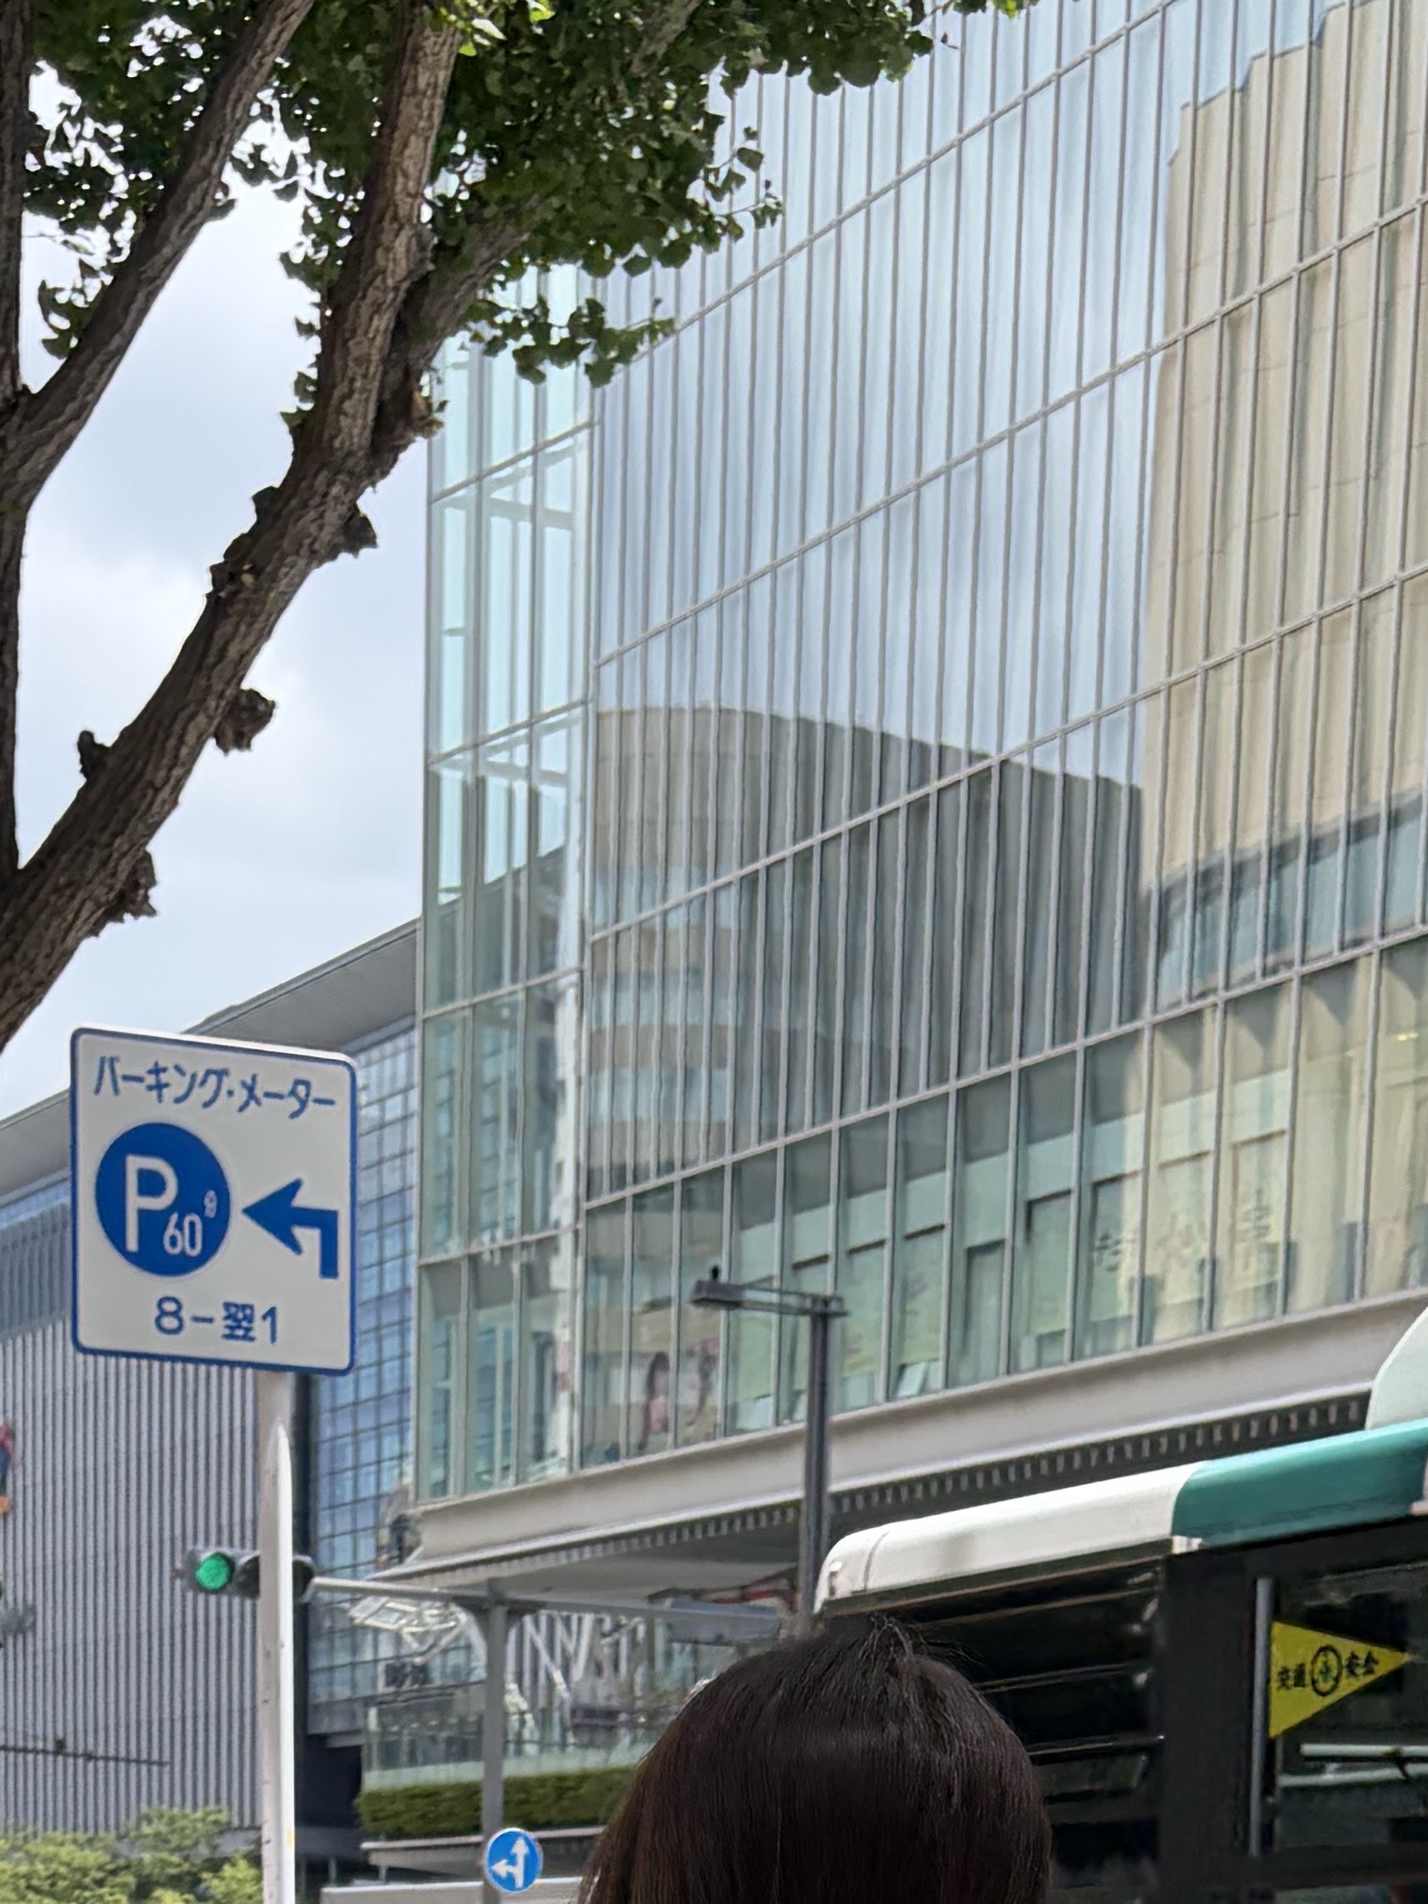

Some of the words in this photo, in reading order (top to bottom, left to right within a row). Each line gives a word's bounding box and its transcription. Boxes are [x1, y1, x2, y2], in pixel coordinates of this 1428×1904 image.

[93, 1056, 336, 1120] パーキング・メーター
[125, 1153, 178, 1253] P
